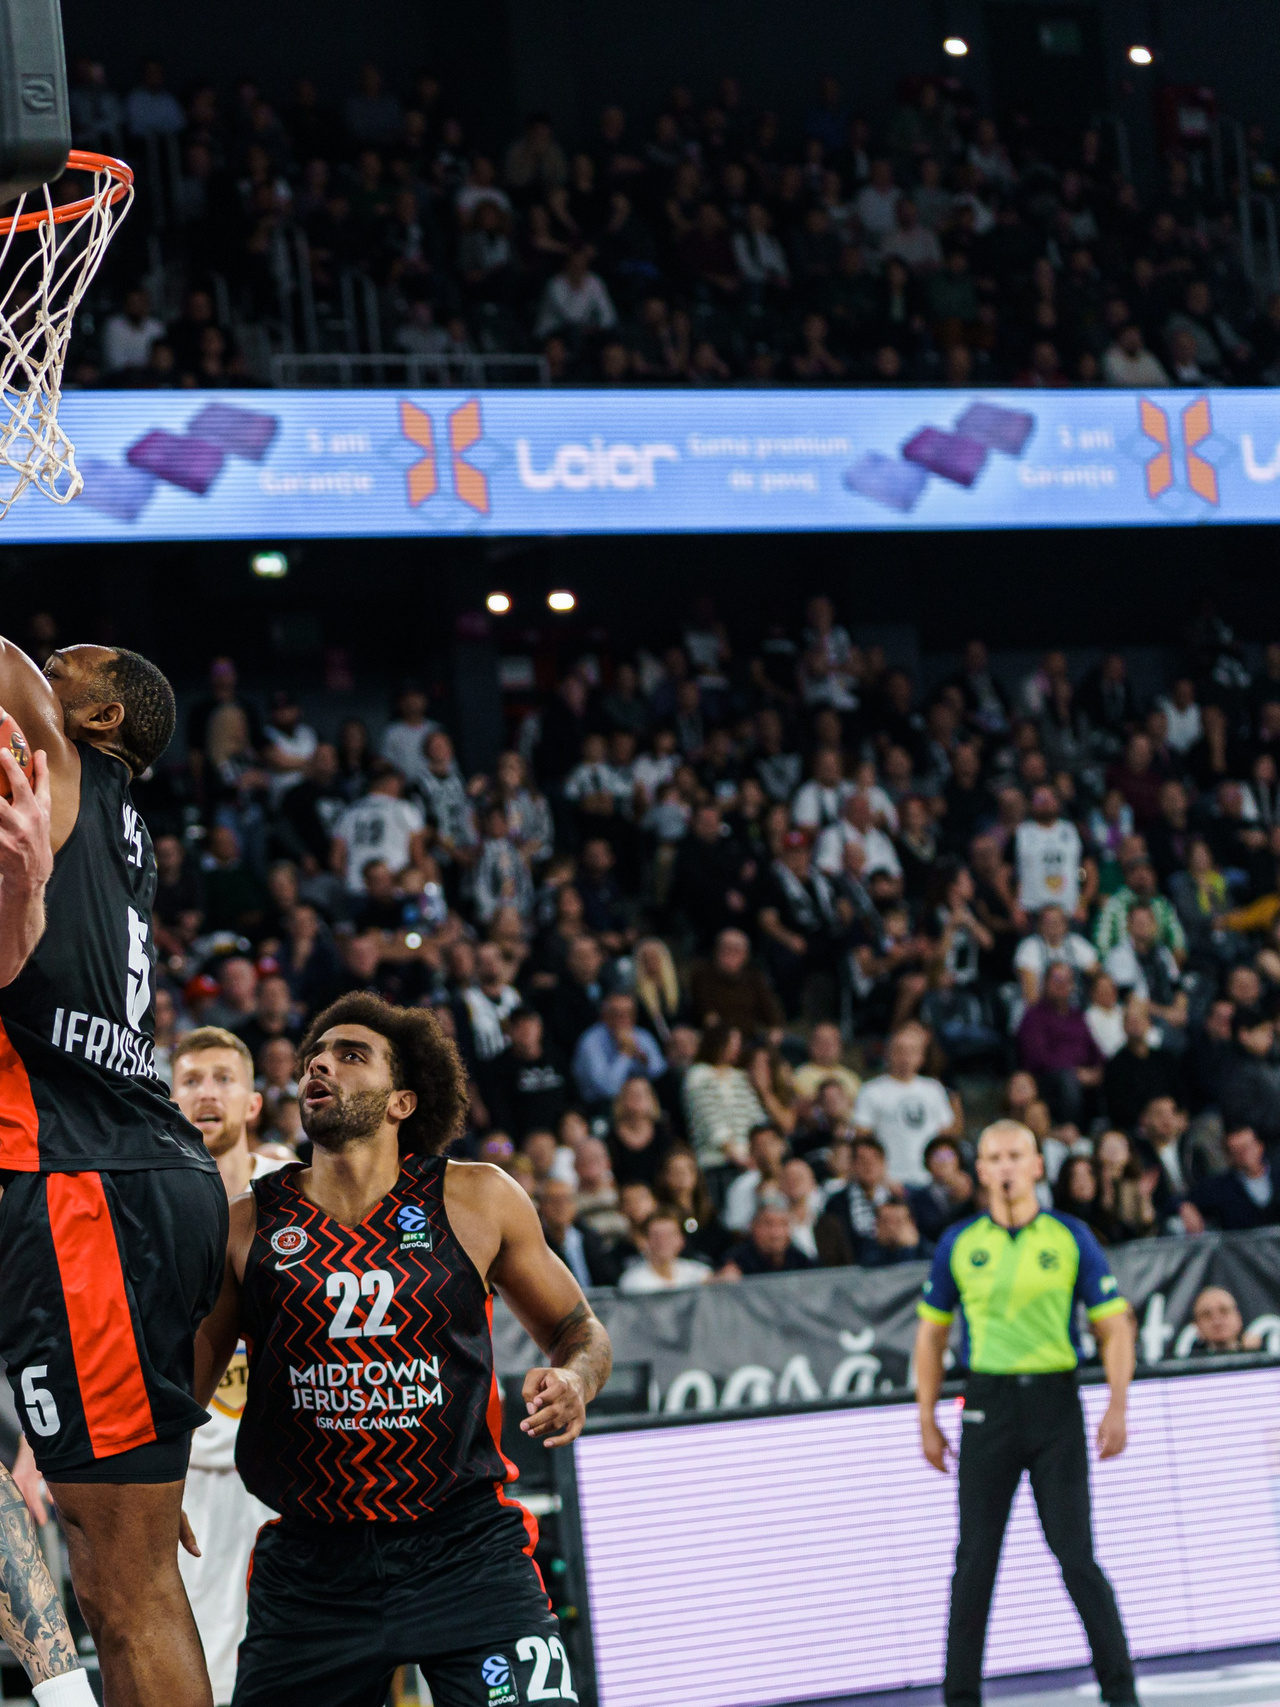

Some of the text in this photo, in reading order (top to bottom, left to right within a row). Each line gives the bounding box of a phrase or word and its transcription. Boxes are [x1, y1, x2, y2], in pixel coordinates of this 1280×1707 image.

[126, 905, 151, 1033] 5
[400, 1240, 430, 1250] EuroCup
[403, 1233, 425, 1241] BKT
[326, 1269, 397, 1338] 22
[289, 1356, 440, 1387] MIDTOWN
[21, 1365, 61, 1437] 5
[292, 1382, 444, 1412] JERUSALEM
[515, 1635, 579, 1703] 22
[488, 1695, 516, 1707] EuroCup
[489, 1685, 510, 1697] BKT
